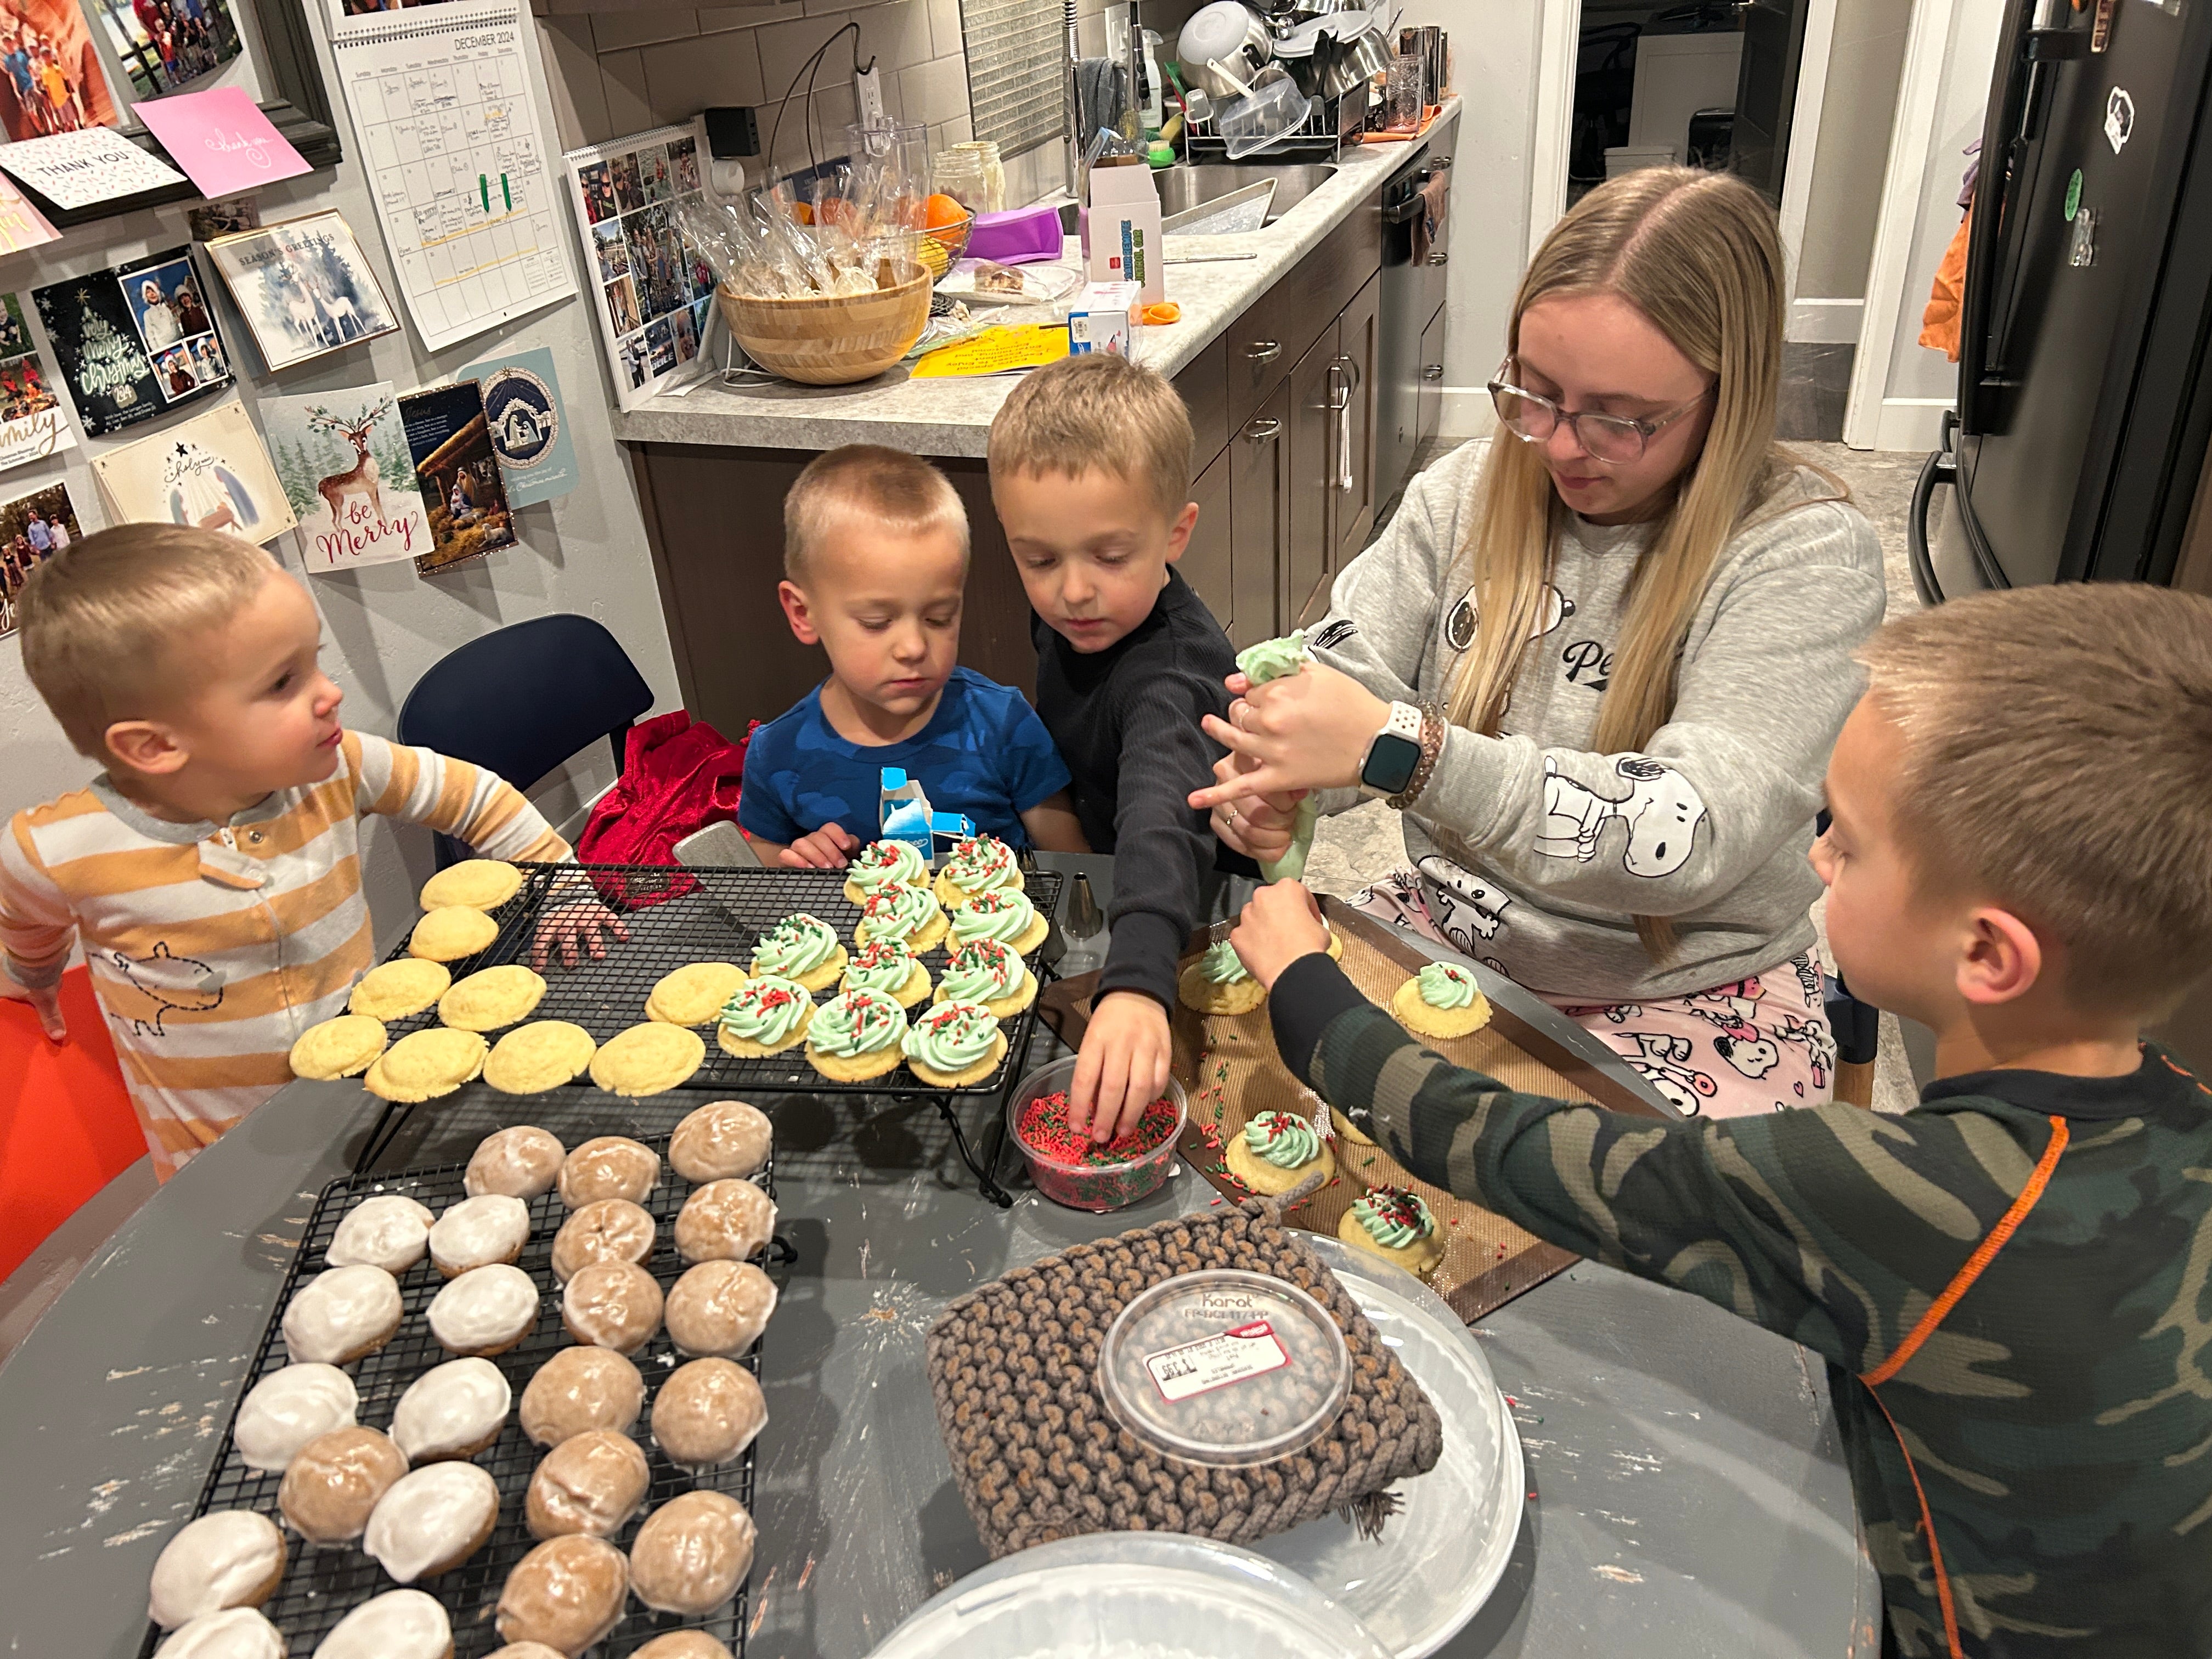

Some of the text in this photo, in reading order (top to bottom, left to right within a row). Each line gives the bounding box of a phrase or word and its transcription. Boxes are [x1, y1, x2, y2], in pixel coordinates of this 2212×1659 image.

[454, 31, 515, 50] DECEMBER 2024
[36, 151, 129, 176] THANK YOU
[239, 233, 335, 266] SEASON'S GREETINGS
[1121, 220, 1133, 280] SAUR REMOTE
[1133, 229, 1145, 288] ONTROL CAR
[345, 501, 372, 524] be
[316, 511, 418, 563] Merry
[1562, 640, 1615, 682] Pe
[1203, 1293, 1253, 1308] Karat
